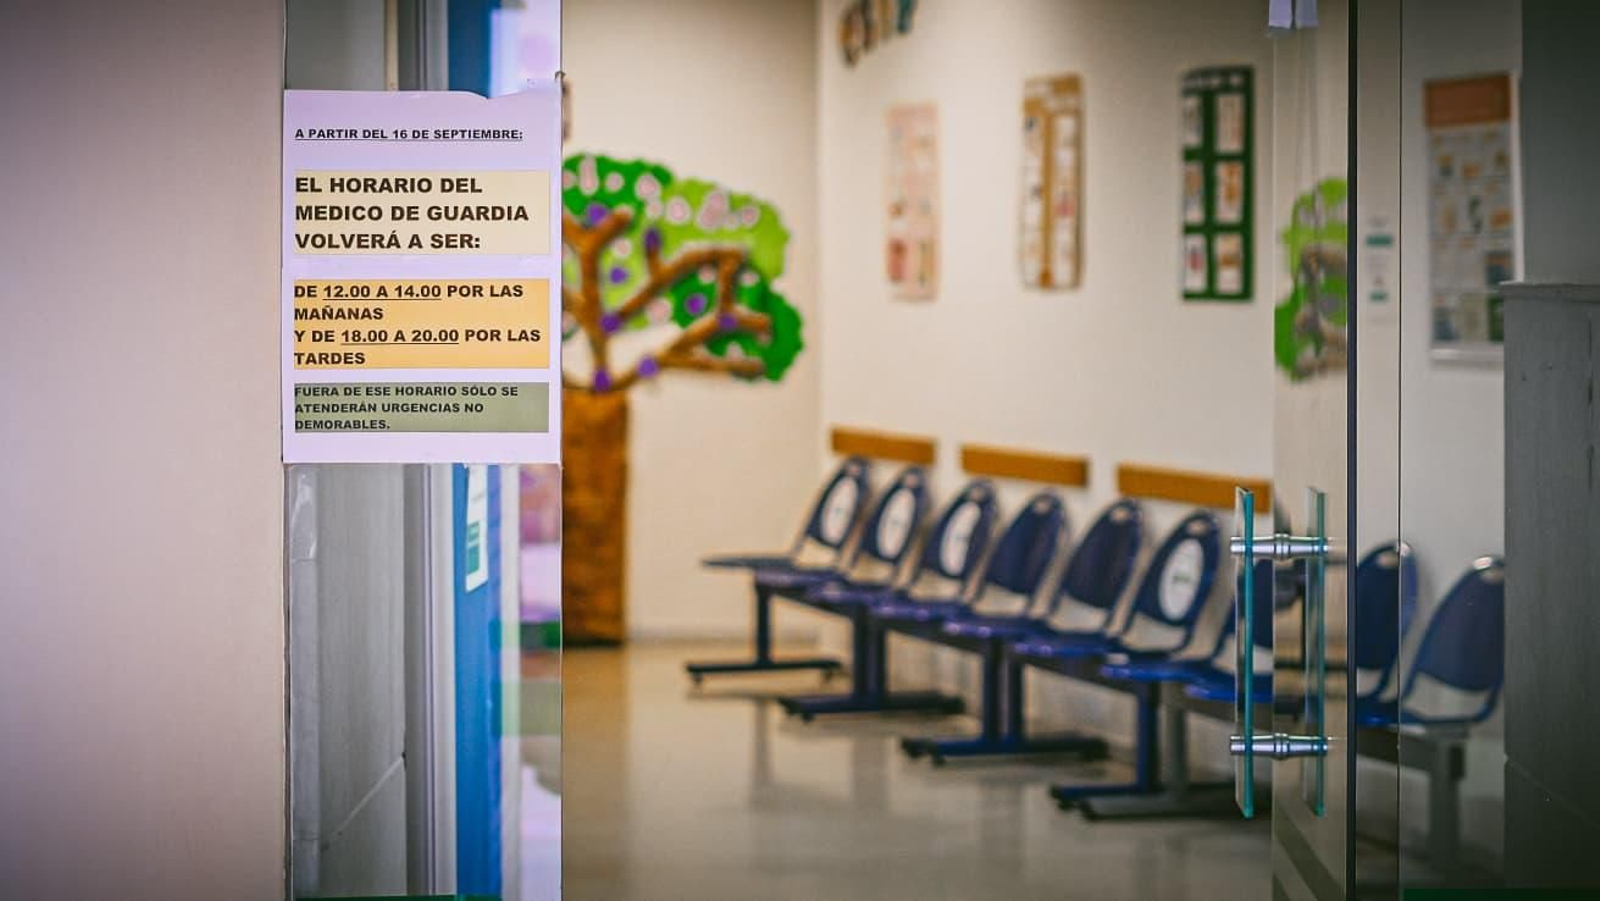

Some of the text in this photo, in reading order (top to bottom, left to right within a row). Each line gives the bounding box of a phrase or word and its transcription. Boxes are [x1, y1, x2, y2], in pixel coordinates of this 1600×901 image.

[295, 129, 523, 139] A PARTIR DEL 16 DE SEPTIEMBRE:
[295, 177, 482, 193] EL HORARIO DEL
[295, 205, 529, 221] MEDICO DE GUARDIA
[295, 230, 480, 249] VOLVERÁ A SER:
[294, 284, 523, 298] DE 12.00 A 14.00 POR LAS
[294, 305, 384, 320] MAÑANAS
[294, 329, 541, 343] Y DE 18.00 A 20.00 POR LAS
[294, 352, 366, 365] TARDES
[294, 384, 518, 397] FUERA DE ESE HORARIO SÓLO SE
[294, 401, 484, 413] ATENDERÁN URGENCIAS NO
[295, 419, 390, 430] DEMORABLES.
